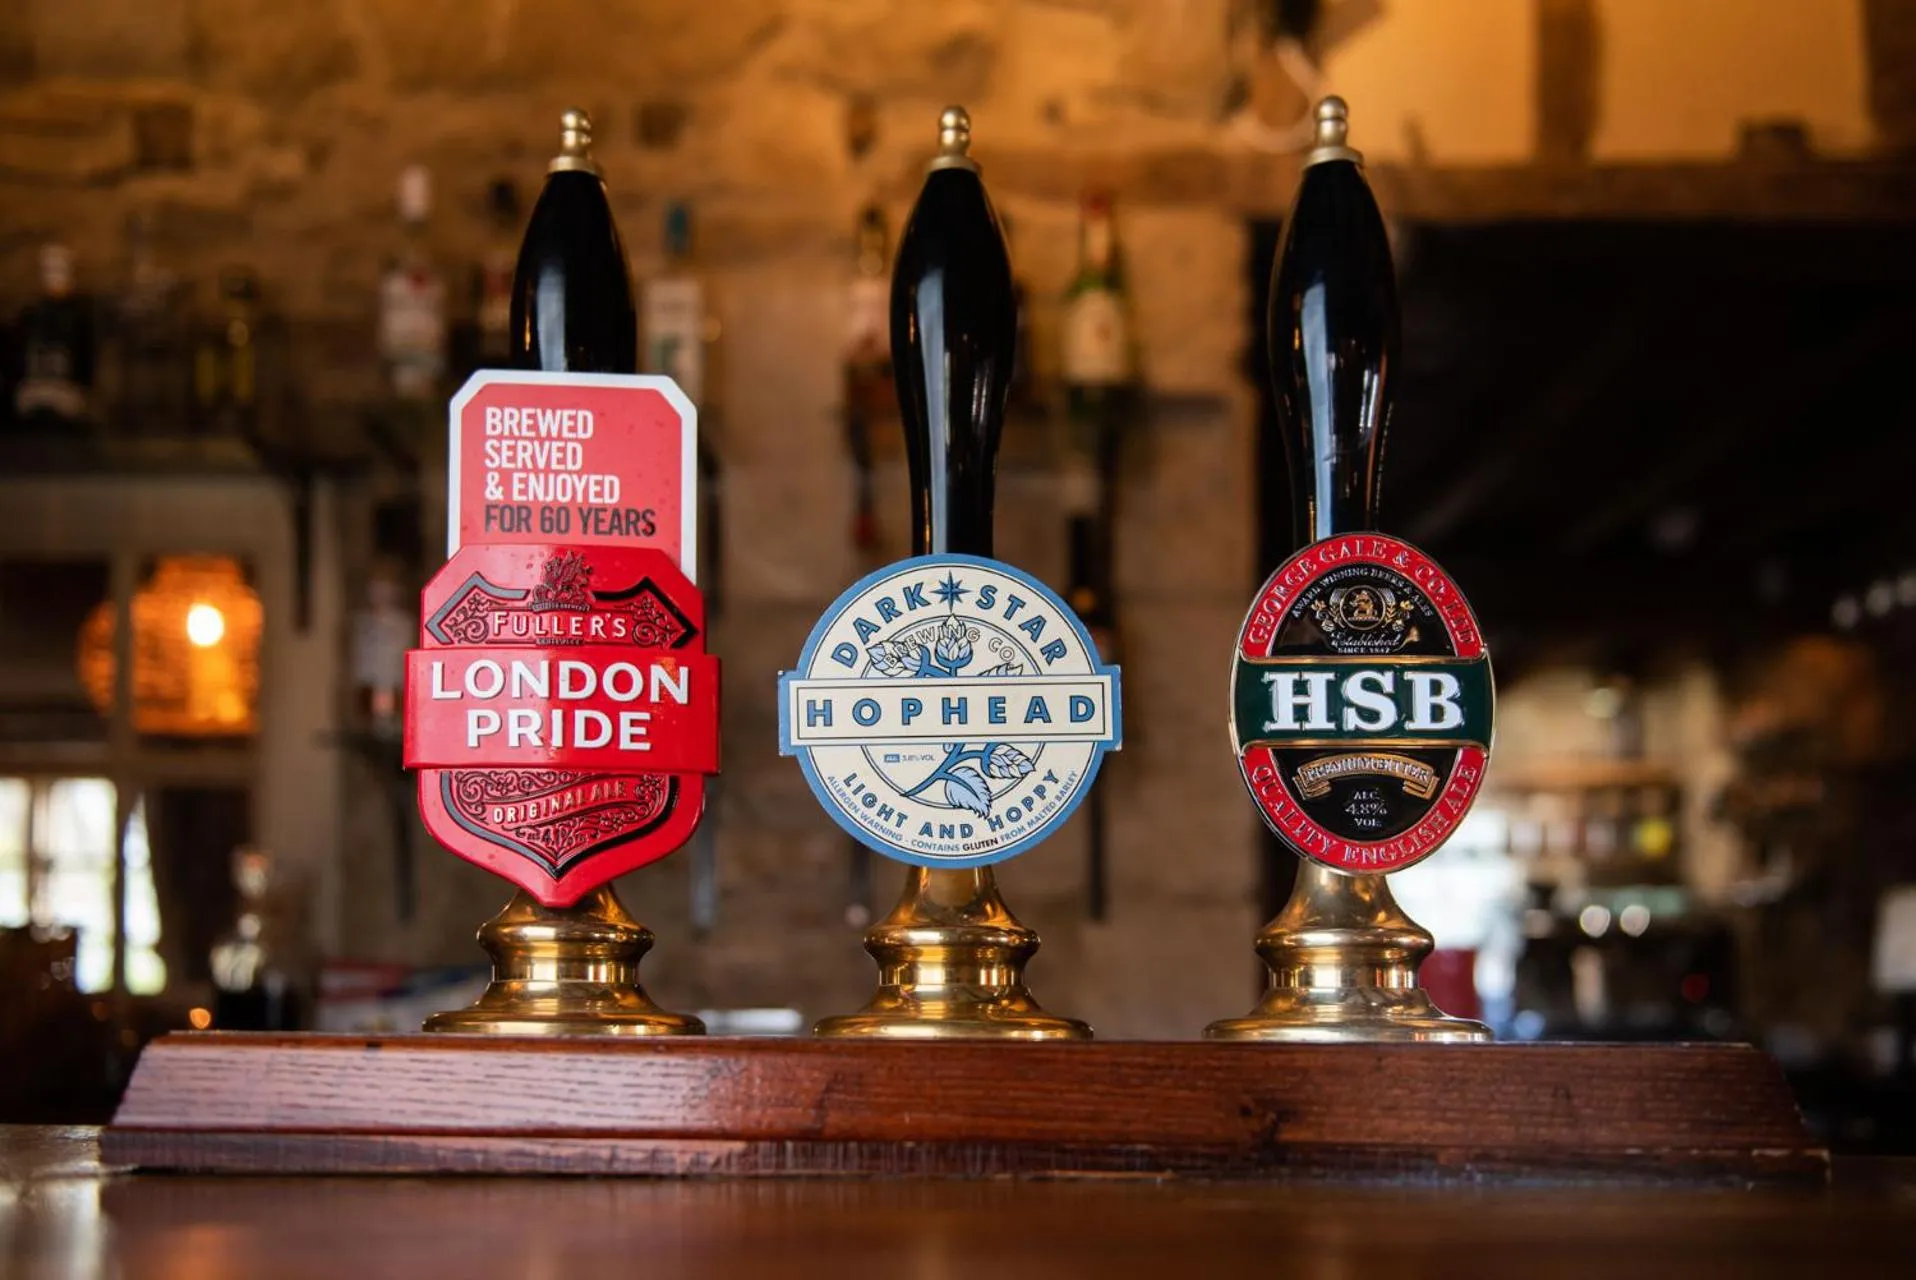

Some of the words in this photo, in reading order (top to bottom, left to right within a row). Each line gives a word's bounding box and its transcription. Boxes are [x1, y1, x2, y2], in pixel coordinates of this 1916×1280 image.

[485, 407, 593, 439] BREWED
[485, 440, 582, 471] SERVED
[485, 473, 503, 500] &
[512, 473, 620, 504] ENJOYED
[485, 504, 532, 533] FOR
[540, 506, 570, 534] 60
[579, 507, 656, 537] YEARS
[1249, 558, 1317, 644] GEORGE
[1319, 540, 1387, 563] GALE
[1391, 551, 1412, 568] &
[493, 611, 627, 638] FULLER'S
[831, 581, 930, 668] DARK
[975, 584, 1067, 665] STAR
[884, 624, 981, 668] BREWING
[431, 659, 690, 705] LONDON
[1262, 670, 1466, 733] HSB
[467, 708, 653, 751] PRIDE
[806, 695, 1097, 727] HOPHEAD
[493, 788, 584, 824] ORIGINAL
[827, 775, 861, 814] ALLERGEN
[860, 811, 903, 842] WARNING
[911, 839, 960, 853] CONTAINS
[962, 837, 998, 852] GLUTEN
[1000, 824, 1026, 842] FROM
[1027, 801, 1056, 828] MALTED
[1055, 771, 1078, 801] BARLEY
[843, 772, 908, 828] LIGHT
[918, 821, 974, 840] AND
[987, 769, 1059, 832] HOPPY
[1252, 765, 1339, 855] QUALITY
[1343, 810, 1450, 864] ENGLISH
[1444, 765, 1477, 814] ALE
